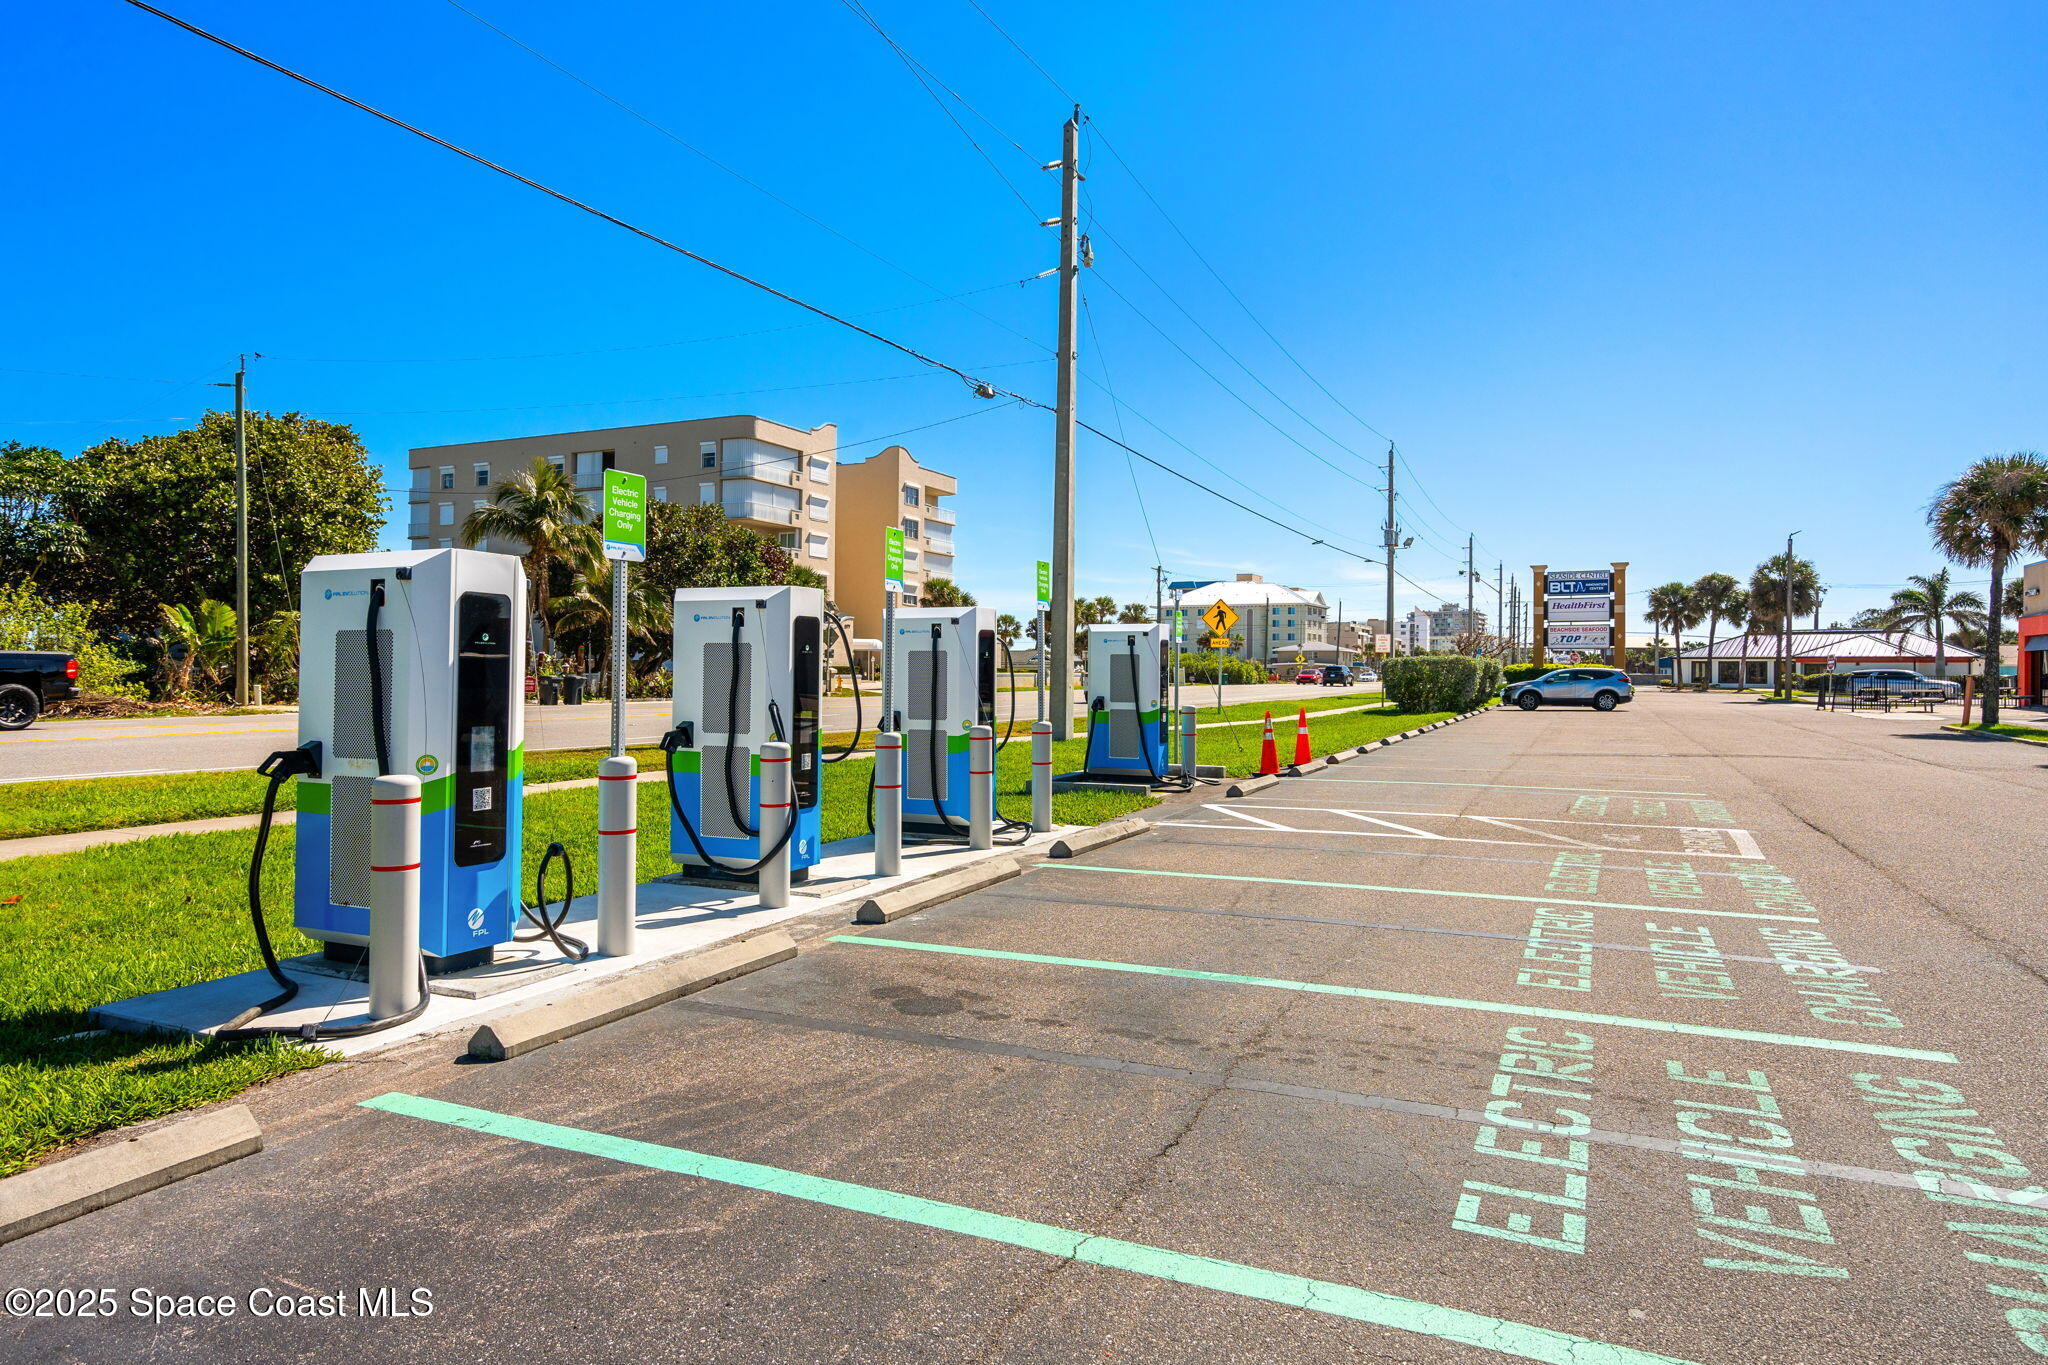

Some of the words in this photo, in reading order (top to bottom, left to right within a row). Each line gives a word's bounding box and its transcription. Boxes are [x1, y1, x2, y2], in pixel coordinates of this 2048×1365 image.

[608, 508, 641, 522] Charging
[612, 486, 638, 498] Electric
[612, 496, 638, 508] Vehicle
[616, 520, 633, 531] Only
[472, 929, 489, 938] FPL
[1516, 907, 1594, 993] ELECTRIC
[1645, 922, 1740, 1000] VEHICLE
[1758, 927, 1904, 1028] CHARGING
[1451, 1025, 1595, 1255] ELECTRIC
[1666, 1059, 1850, 1279] VEHICLE
[1850, 1072, 2048, 1358] ARGING
